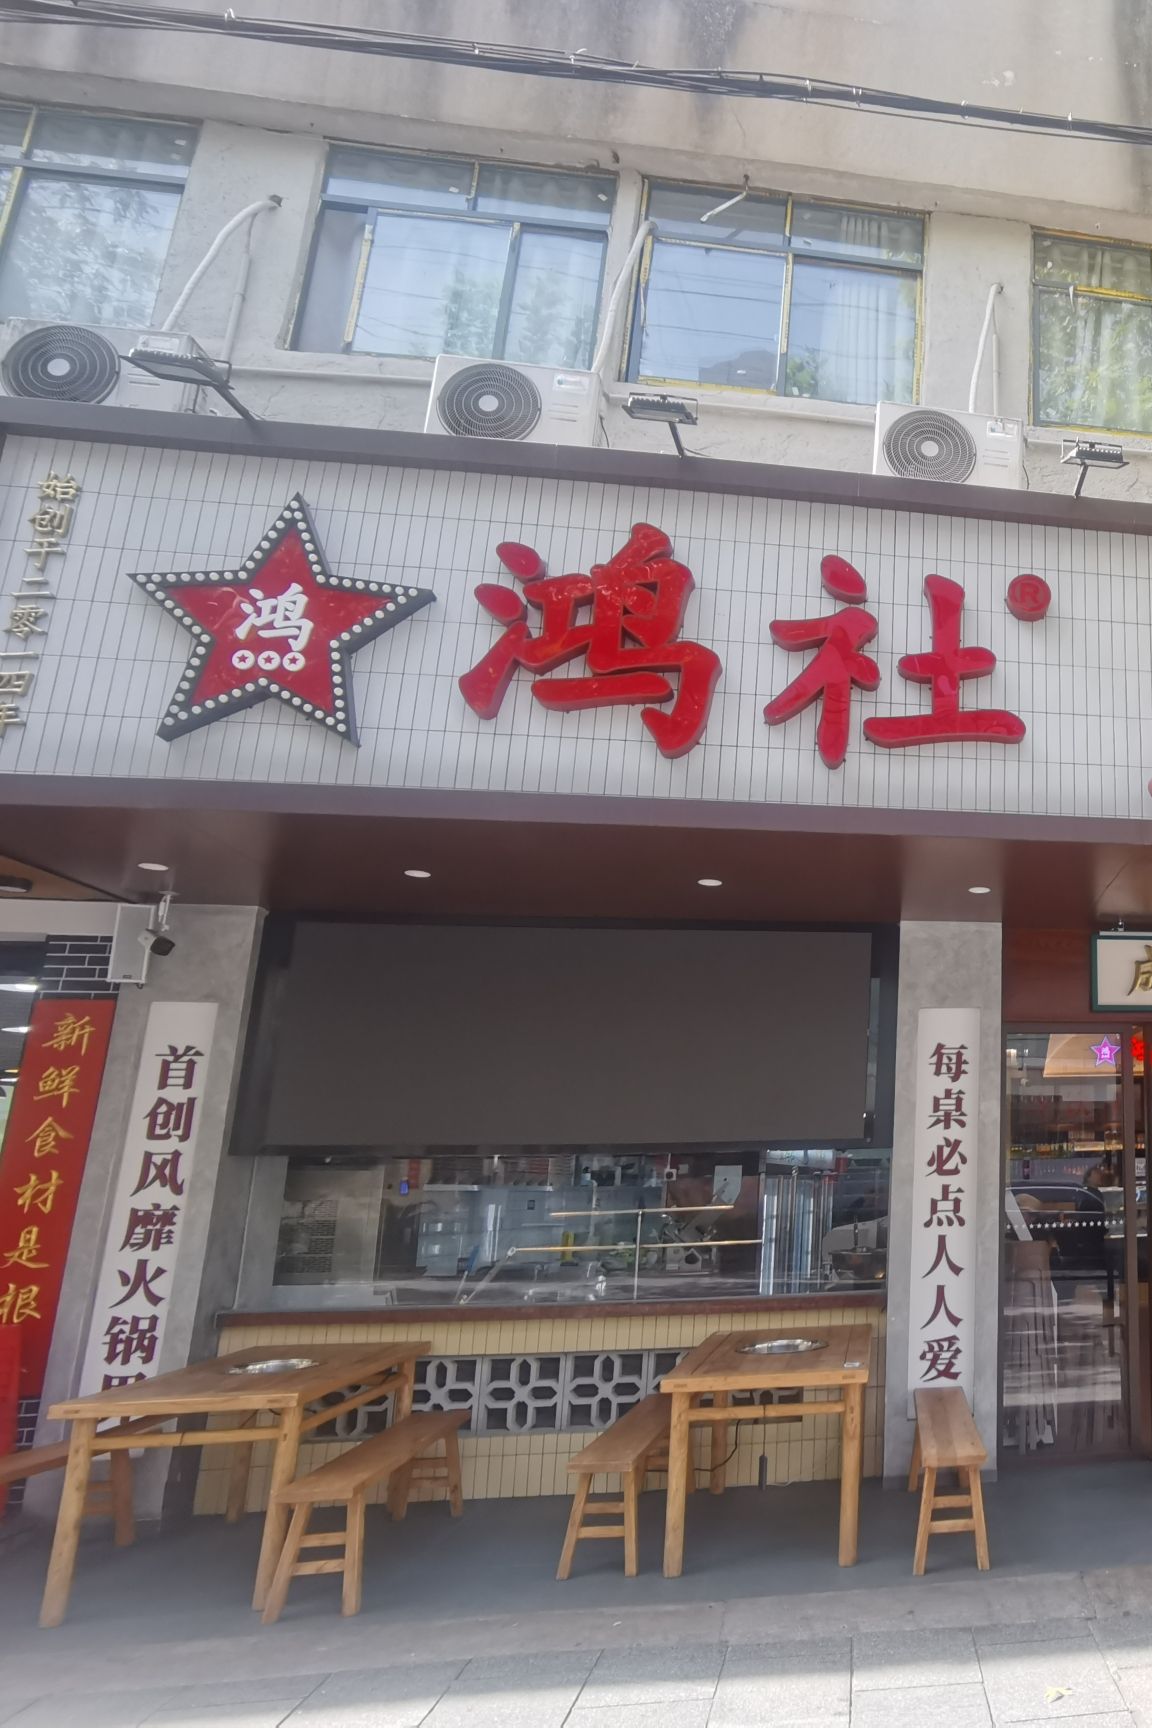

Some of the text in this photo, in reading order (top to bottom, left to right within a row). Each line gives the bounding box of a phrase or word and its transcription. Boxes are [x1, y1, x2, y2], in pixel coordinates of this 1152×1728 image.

[236, 582, 315, 650] 鸿
[459, 522, 1027, 769] 鸿社
[919, 1042, 968, 1382] 每桌必点人人爱
